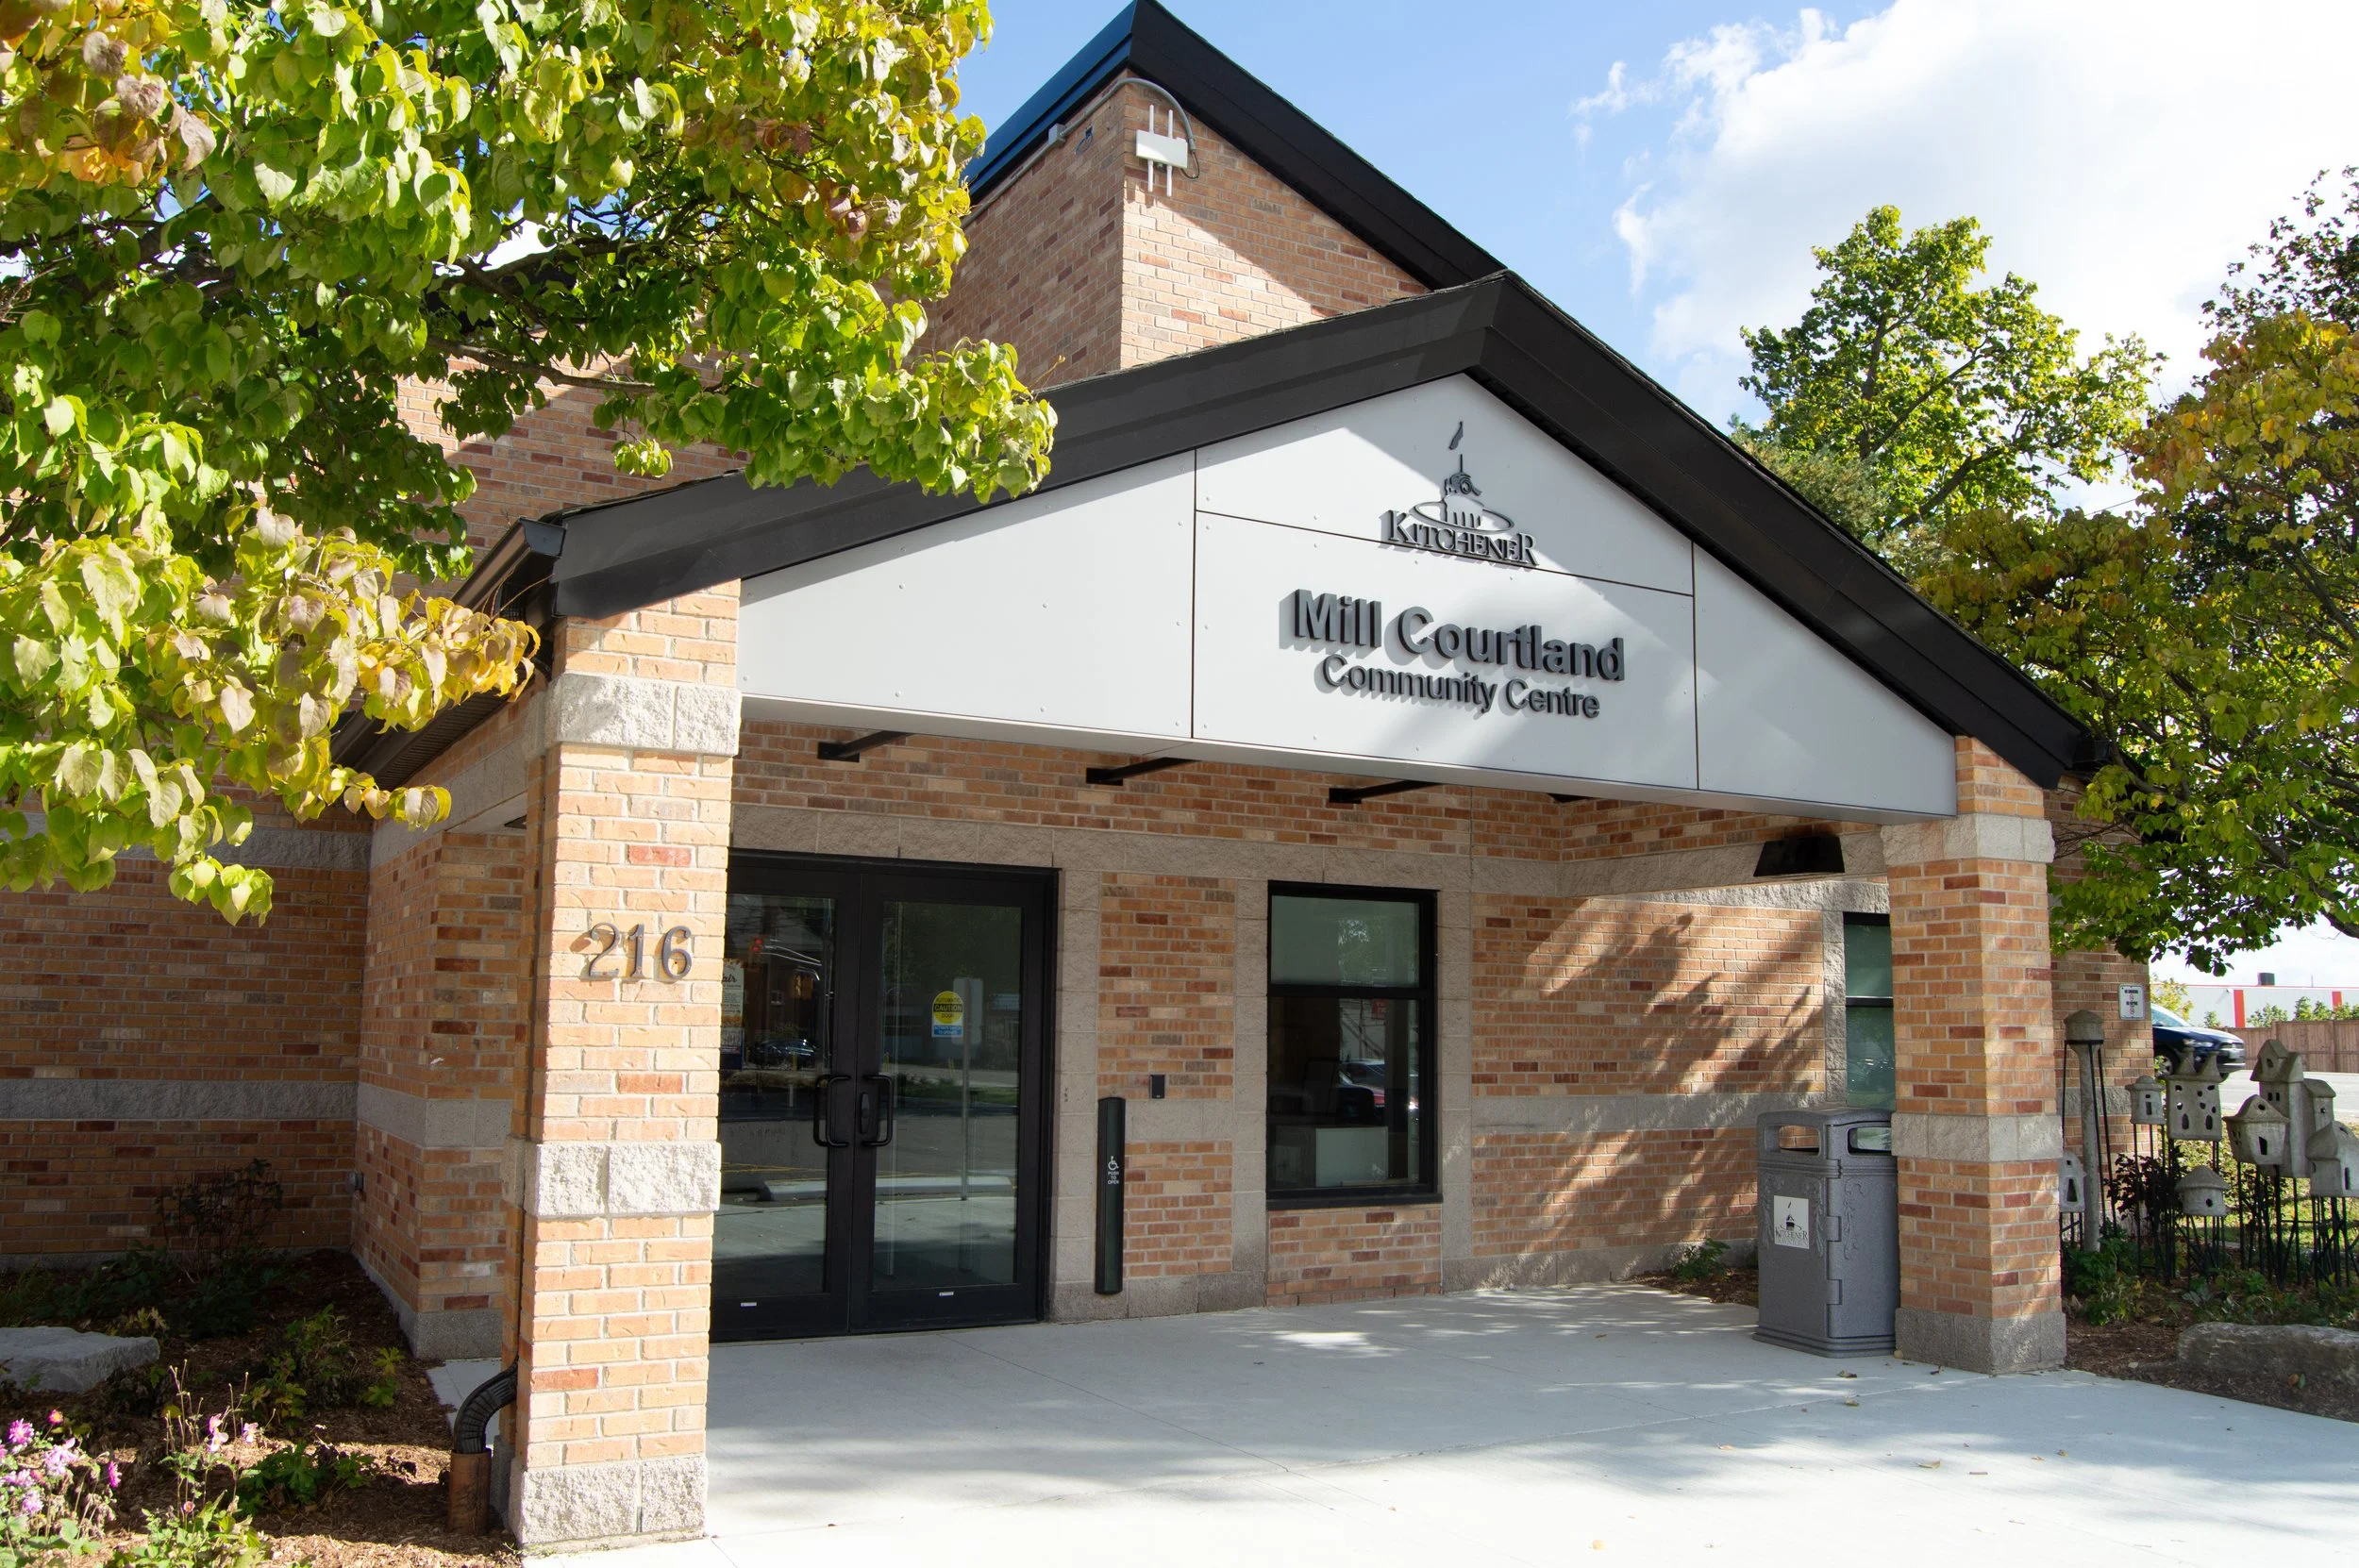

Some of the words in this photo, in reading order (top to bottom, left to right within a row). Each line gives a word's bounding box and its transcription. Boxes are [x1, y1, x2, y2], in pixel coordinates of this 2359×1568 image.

[1387, 510, 1539, 566] KITCHENER
[1295, 589, 1382, 649] Mill
[1397, 606, 1626, 681] Courtland
[1322, 654, 1498, 714] Community
[1505, 678, 1601, 719] Centre
[588, 922, 693, 979] 216
